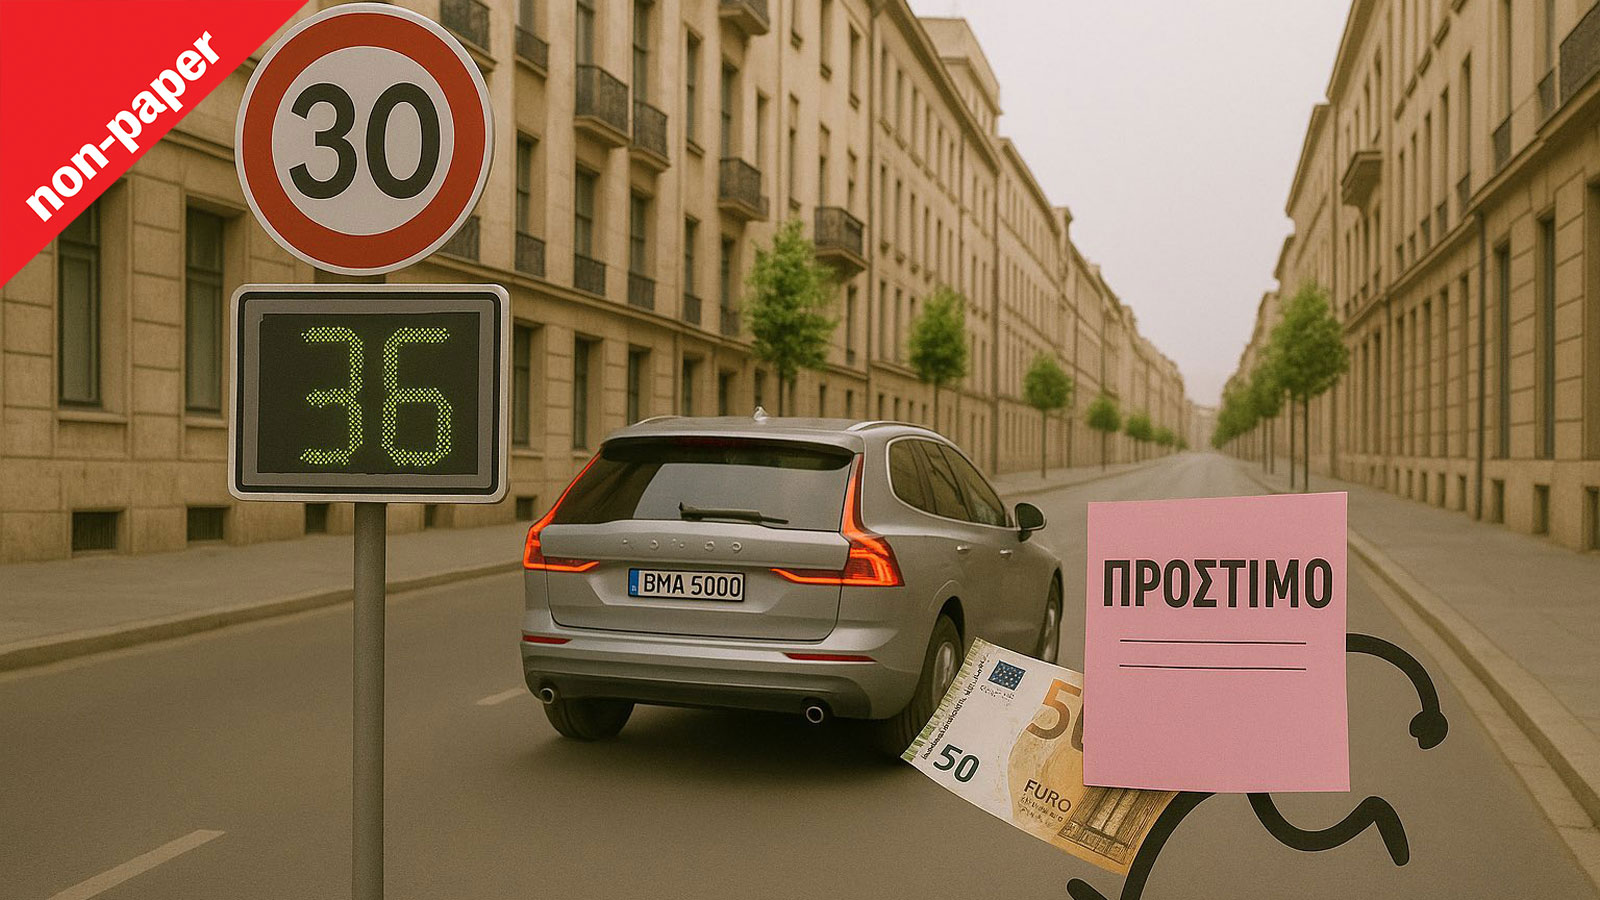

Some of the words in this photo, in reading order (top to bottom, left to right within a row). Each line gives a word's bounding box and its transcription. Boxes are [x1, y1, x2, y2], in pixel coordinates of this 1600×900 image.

[289, 82, 441, 200] 30
[300, 326, 453, 467] 36
[691, 575, 741, 597] 5000
[1103, 558, 1333, 609] ΠΡΟΣΤΙΜΟ
[932, 743, 980, 783] 50
